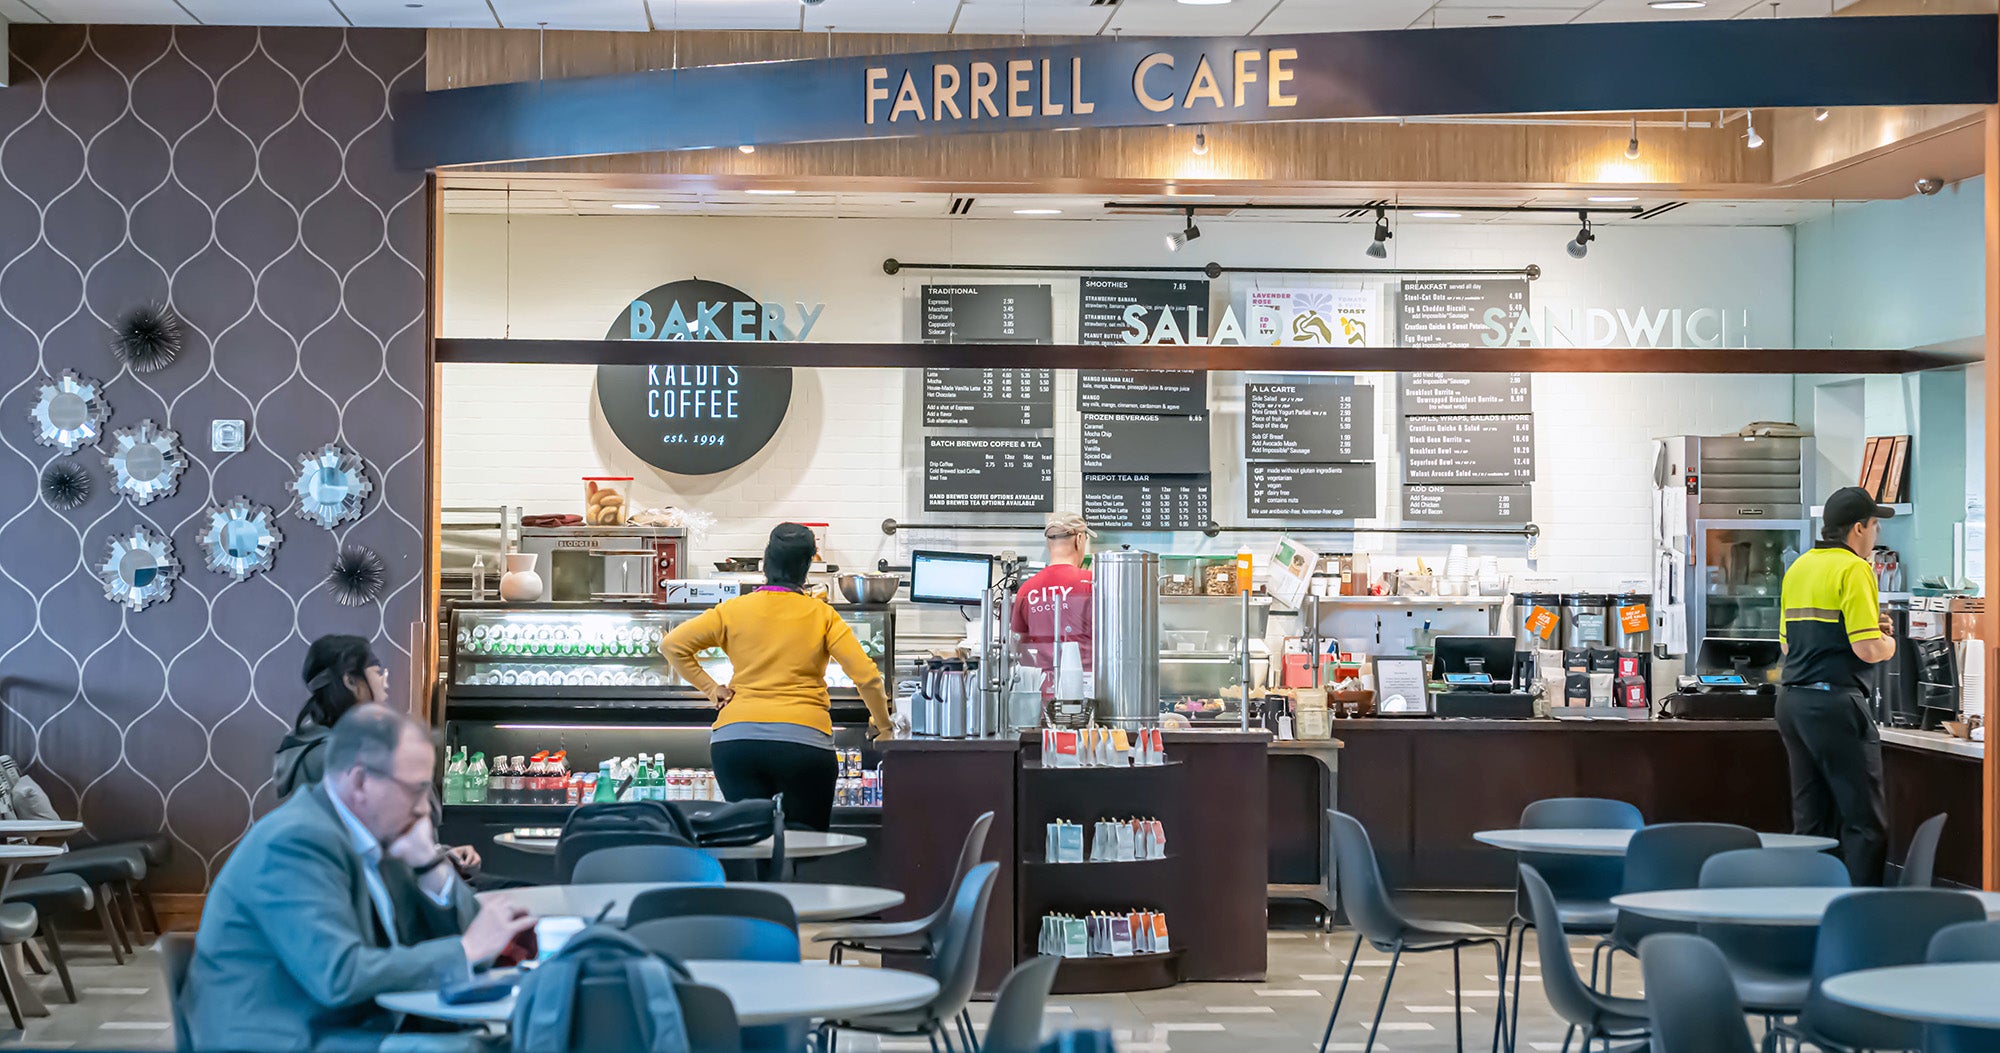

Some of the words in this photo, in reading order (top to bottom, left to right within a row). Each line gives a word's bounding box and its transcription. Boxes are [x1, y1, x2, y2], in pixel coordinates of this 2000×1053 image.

[865, 57, 1095, 124] FARRELL
[1132, 49, 1298, 112] CAFE
[630, 300, 825, 341] BAKERY
[1121, 304, 1284, 345] SALAD
[1481, 305, 1747, 348] SANDWICH
[649, 390, 739, 418] COFFEE
[664, 434, 688, 443] est.
[694, 434, 724, 445] 1994
[1028, 586, 1073, 605] CITY
